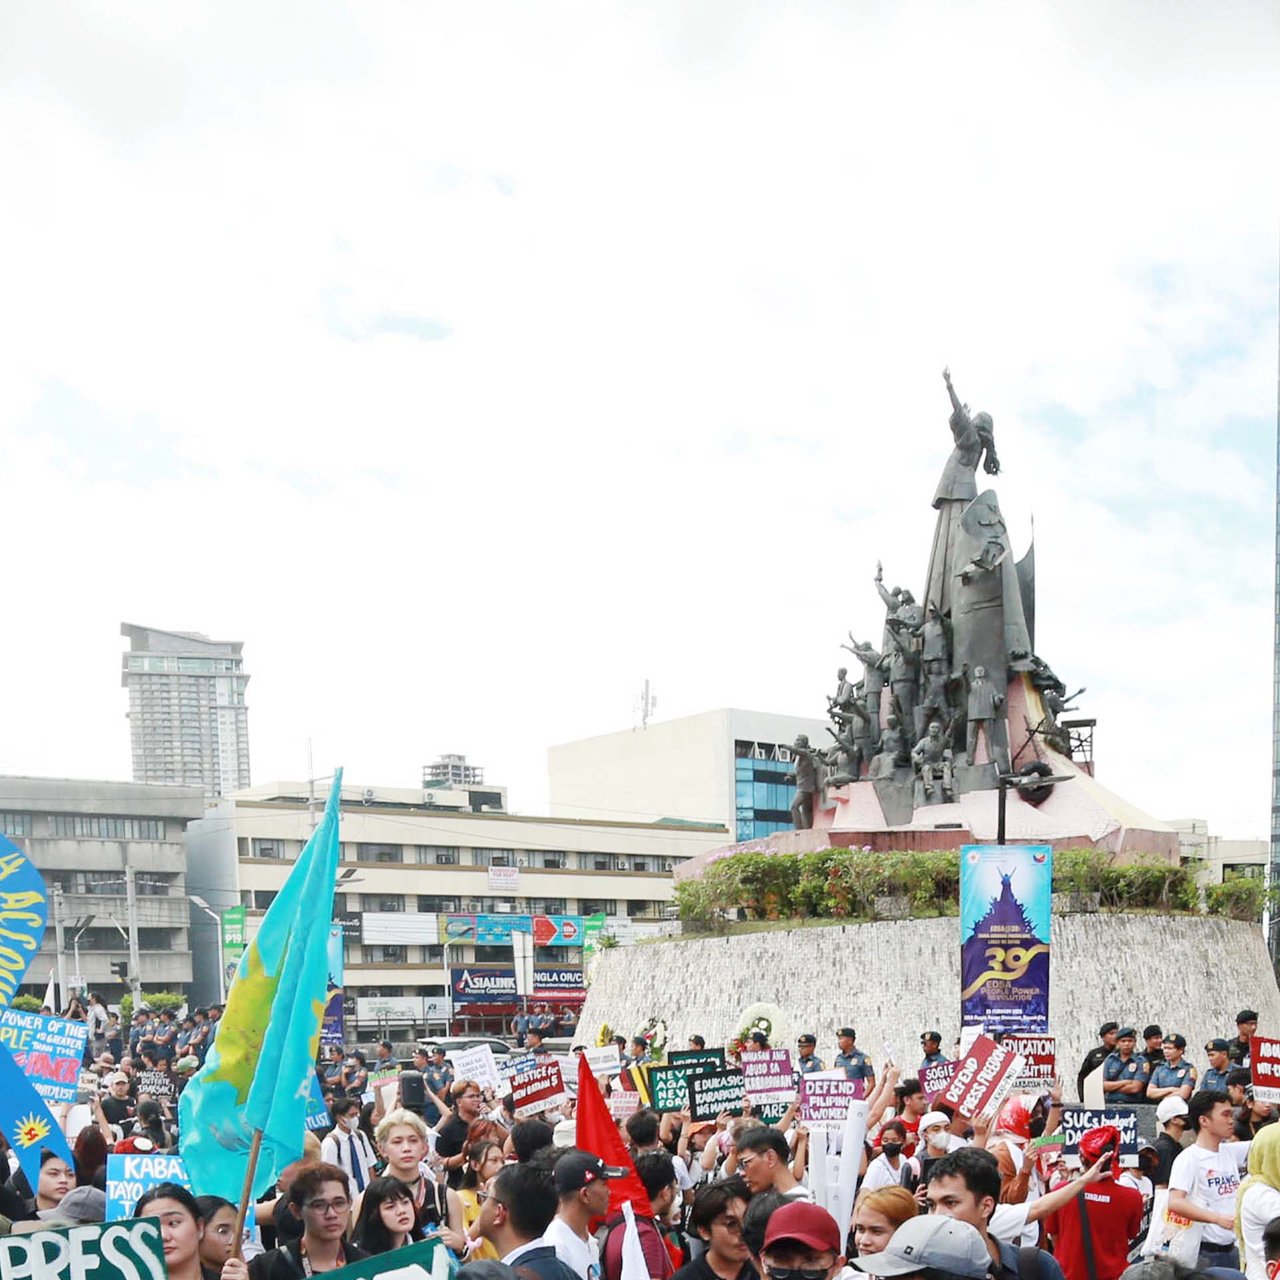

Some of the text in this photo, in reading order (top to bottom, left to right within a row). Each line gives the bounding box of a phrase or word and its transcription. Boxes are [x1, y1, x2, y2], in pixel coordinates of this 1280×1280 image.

[459, 969, 516, 989] ASIALINK
[1, 1011, 89, 1038] POWER OF THE
[31, 1041, 76, 1057] THAN THE
[46, 1035, 84, 1050] GREATER
[772, 1050, 787, 1061] ANG
[136, 1070, 168, 1081] MARCOS-
[513, 1065, 559, 1085] JUSTICE for
[656, 1067, 703, 1080] NEVER
[745, 1062, 781, 1076] ABUSO SA
[925, 1064, 956, 1080] SOGIE
[694, 1074, 745, 1092] EDUKASYO
[805, 1081, 856, 1095] DEFEND
[945, 1057, 979, 1104] DEFEND
[959, 1082, 987, 1119] PRESS
[976, 1043, 1009, 1087] FREEDOM
[513, 1089, 526, 1101] NEW
[526, 1081, 551, 1096] BATAAN
[810, 1095, 853, 1108] FILIPINO
[810, 1107, 849, 1121] WOMEN
[1062, 1110, 1099, 1129] SUCs
[107, 1180, 143, 1200] TAYO
